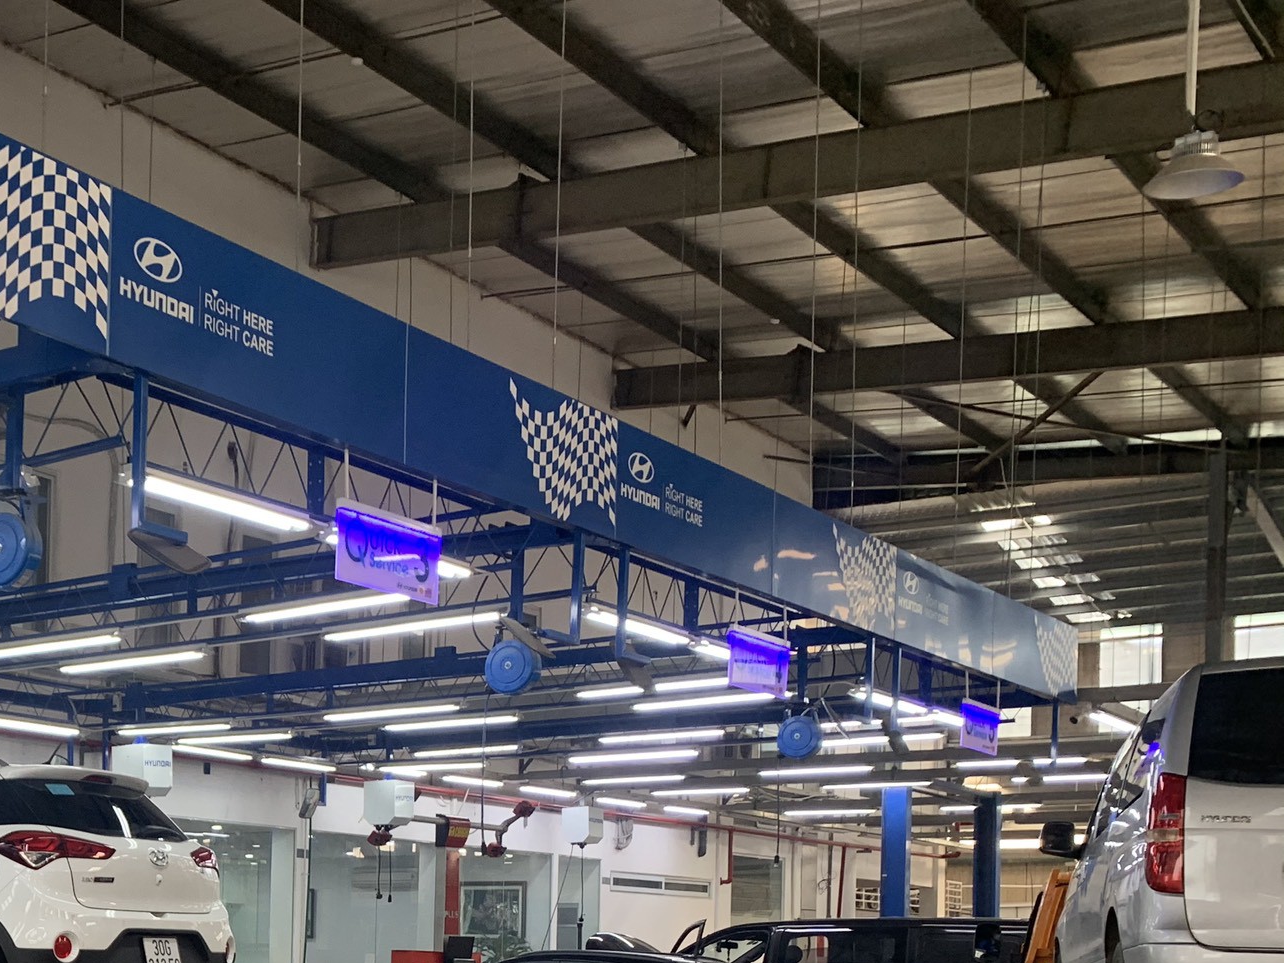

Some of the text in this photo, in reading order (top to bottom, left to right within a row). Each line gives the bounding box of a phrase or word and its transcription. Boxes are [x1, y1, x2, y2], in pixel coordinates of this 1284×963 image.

[119, 276, 194, 325] HYUNDAI
[204, 289, 274, 336] RIGHT HERE
[204, 313, 274, 357] RIGHT CARE
[620, 481, 661, 511] HYUNDAI
[665, 483, 703, 512] RIGHT HERE
[664, 502, 703, 527] RIGHT CARE
[152, 939, 171, 956] 30G
